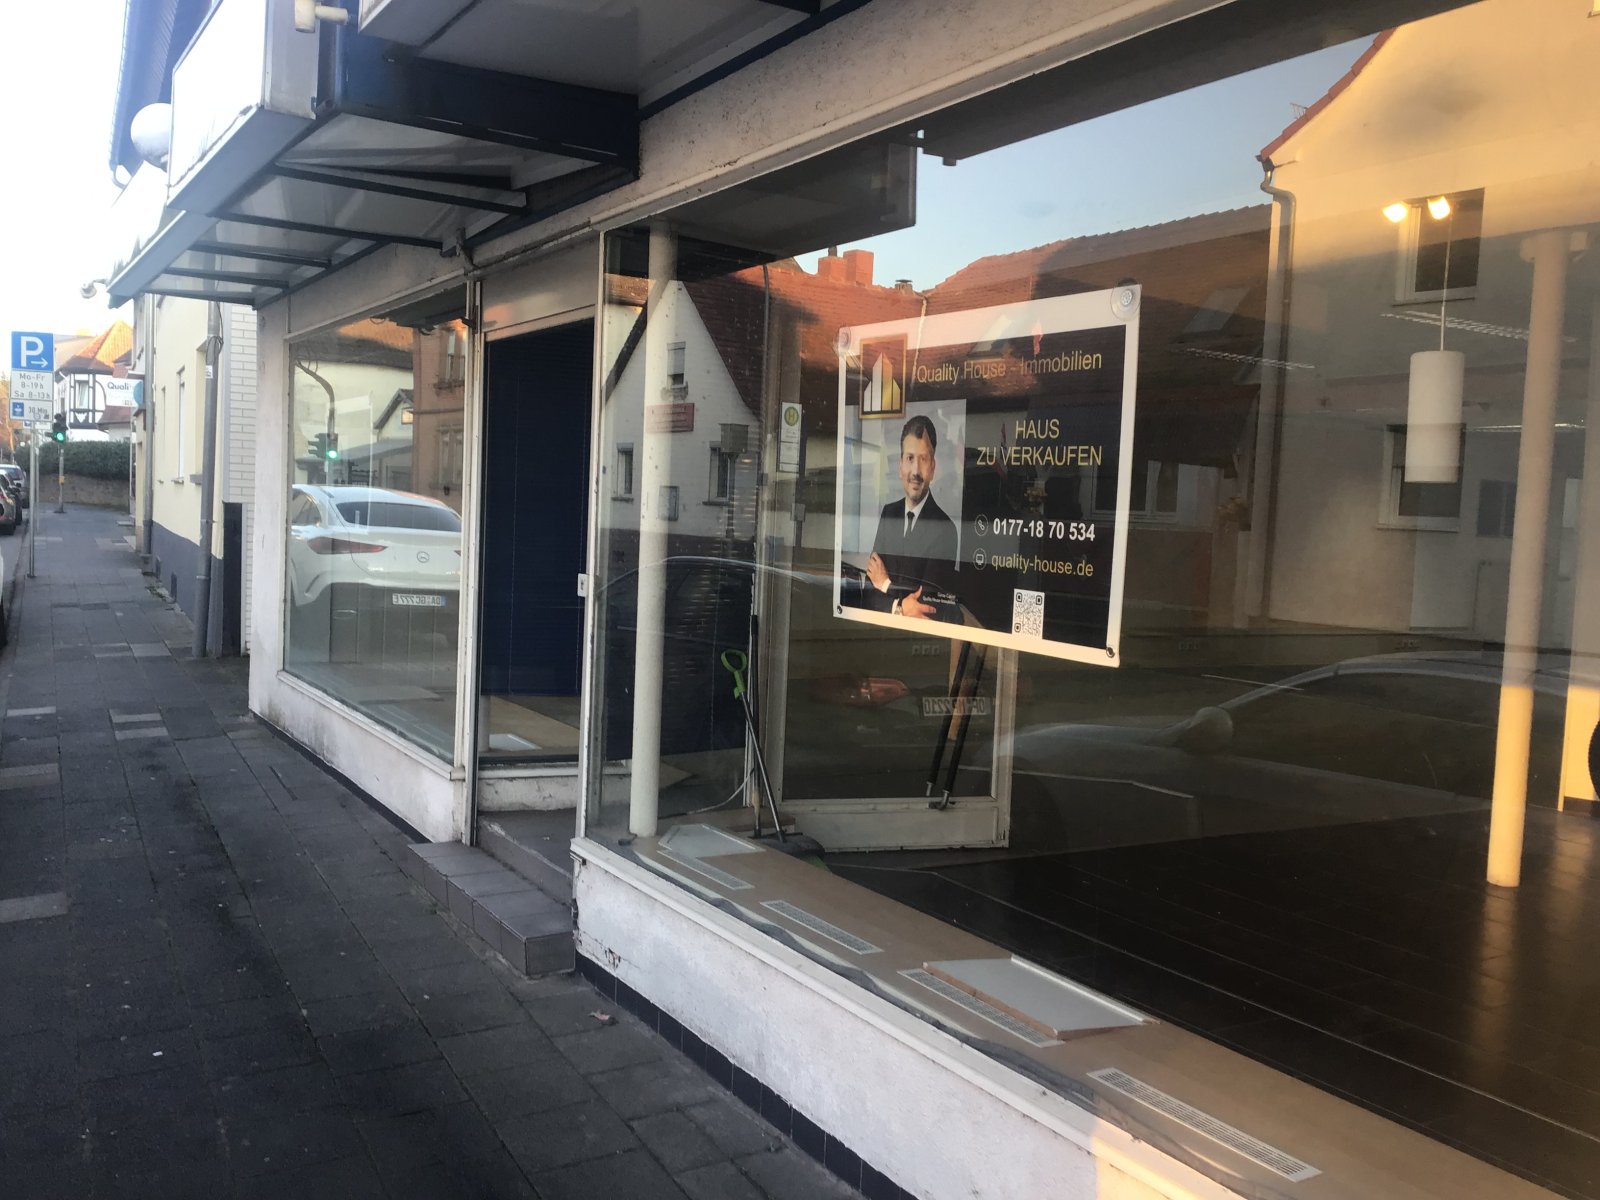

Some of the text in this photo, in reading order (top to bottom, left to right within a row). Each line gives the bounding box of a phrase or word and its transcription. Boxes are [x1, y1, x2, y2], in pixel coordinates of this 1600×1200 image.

[21, 336, 44, 367] P
[20, 372, 45, 380] Mo-Fr
[917, 363, 960, 385] Quality
[963, 361, 1006, 380] House
[1020, 350, 1102, 375] Immobilien
[1015, 418, 1060, 439] HAUS
[976, 445, 1102, 466] ZU VERKAUFEN
[993, 518, 1096, 541] 0177-18 70 534
[991, 553, 1094, 576] quality-house.de
